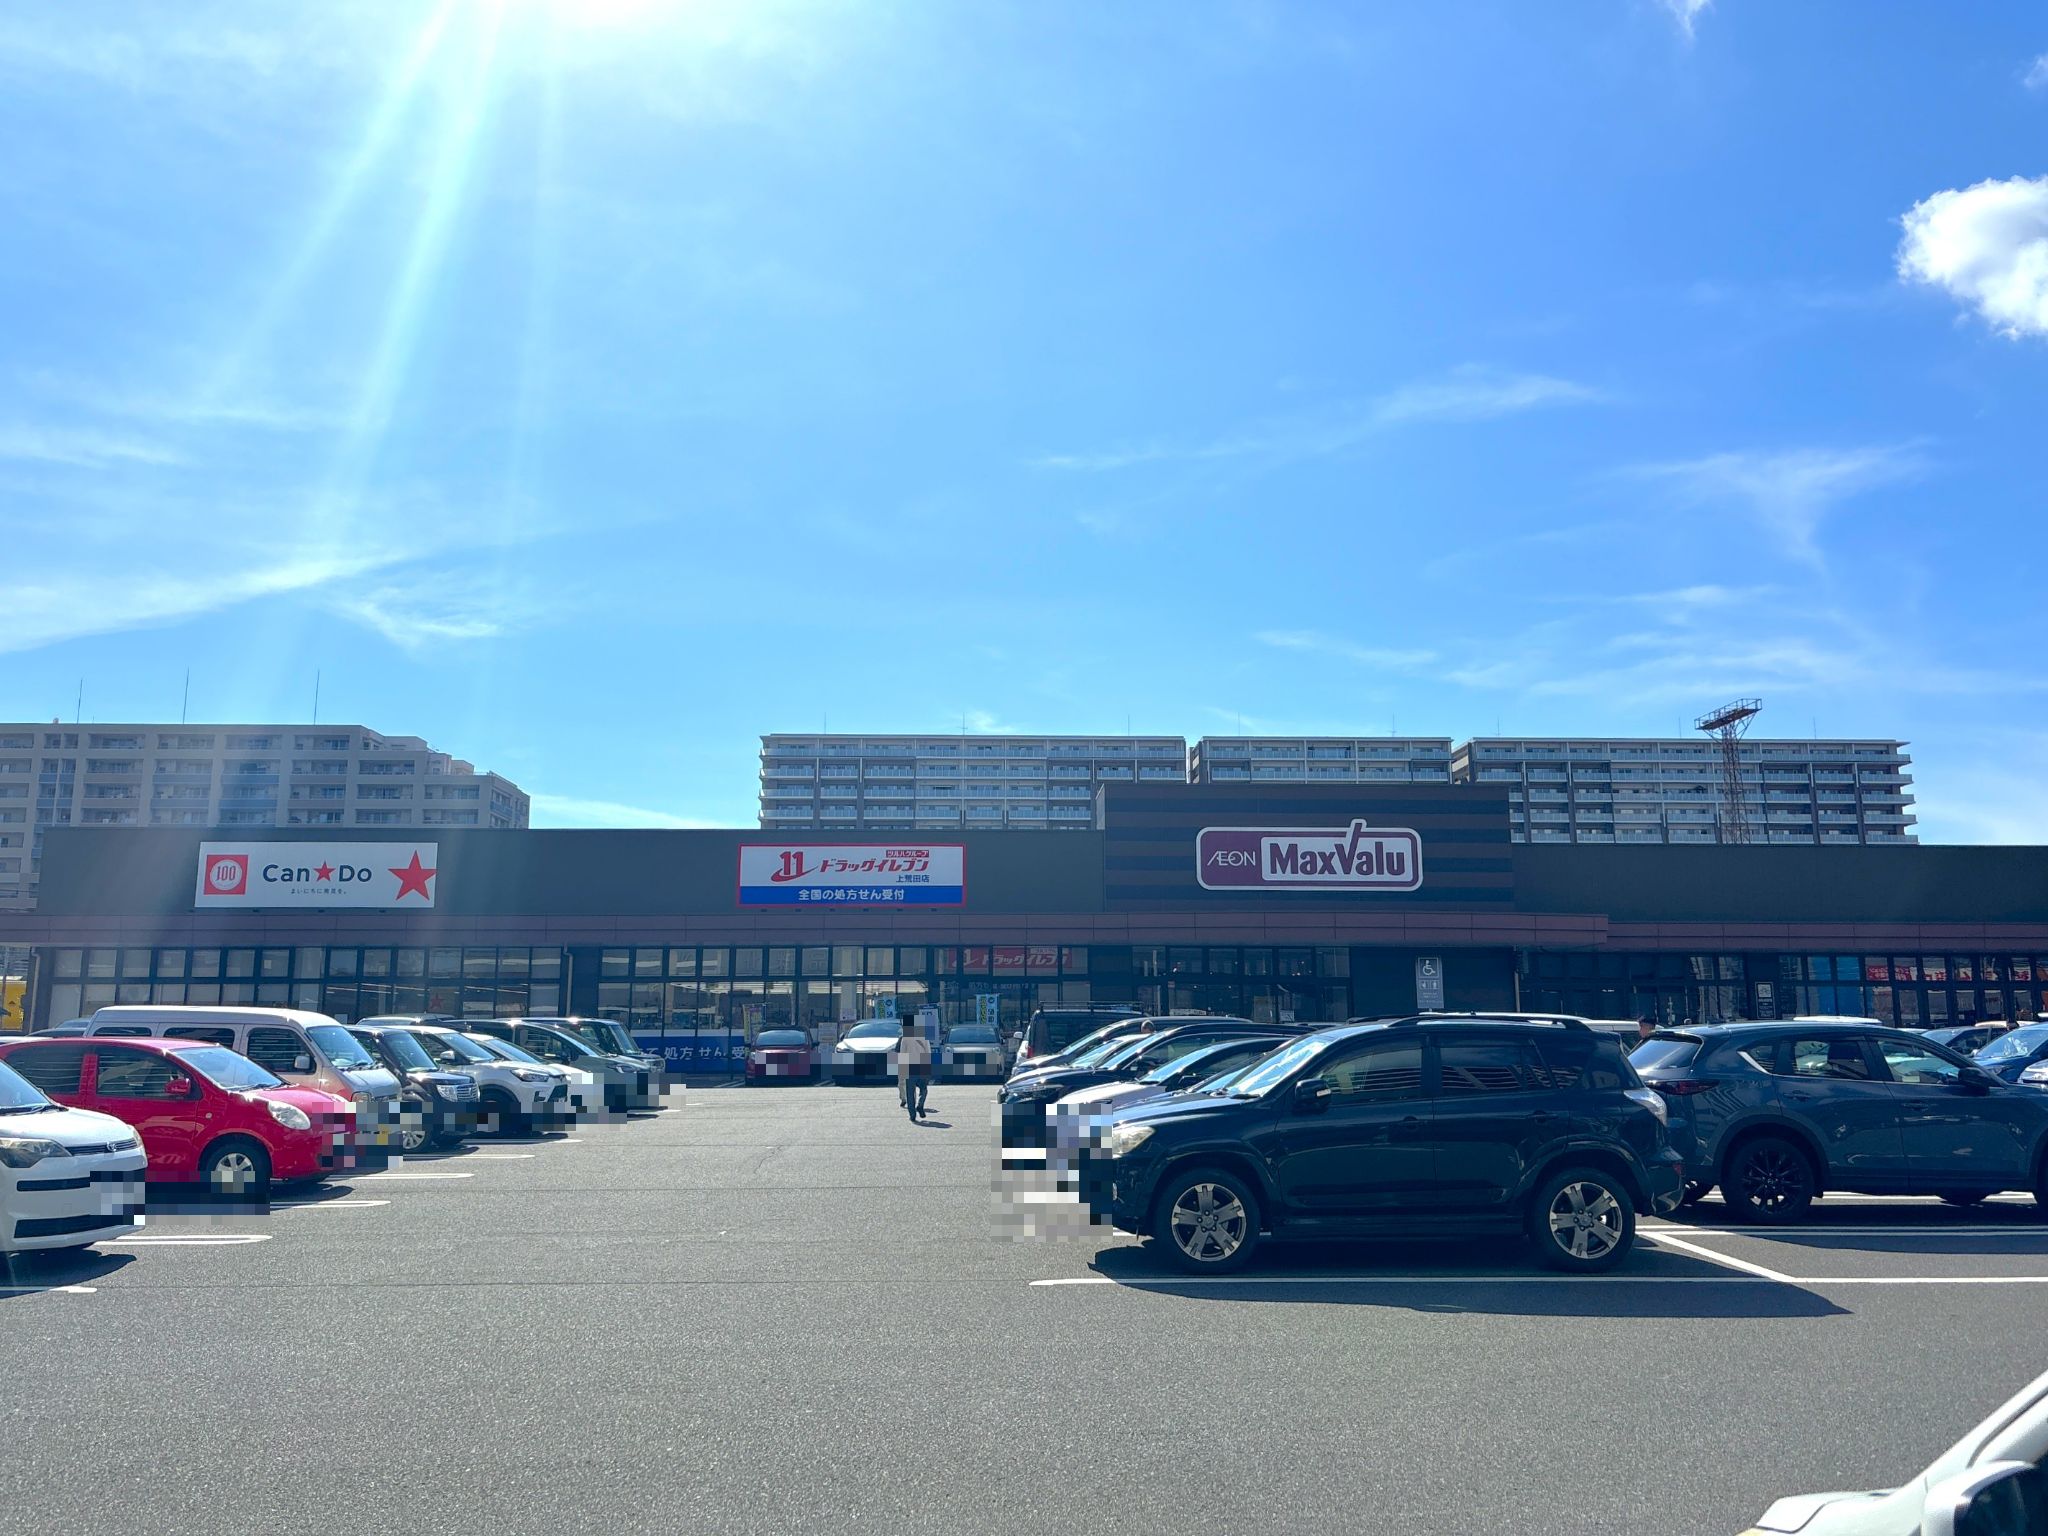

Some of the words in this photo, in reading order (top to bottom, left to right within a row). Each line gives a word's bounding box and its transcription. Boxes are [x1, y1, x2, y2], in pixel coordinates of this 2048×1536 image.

[1269, 823, 1406, 876] MaxValu
[820, 858, 930, 872] ドラッグイレブン
[216, 866, 236, 881] 100
[262, 864, 310, 883] Can
[338, 865, 372, 883] Do
[798, 888, 905, 901] 全国の処方せん受付
